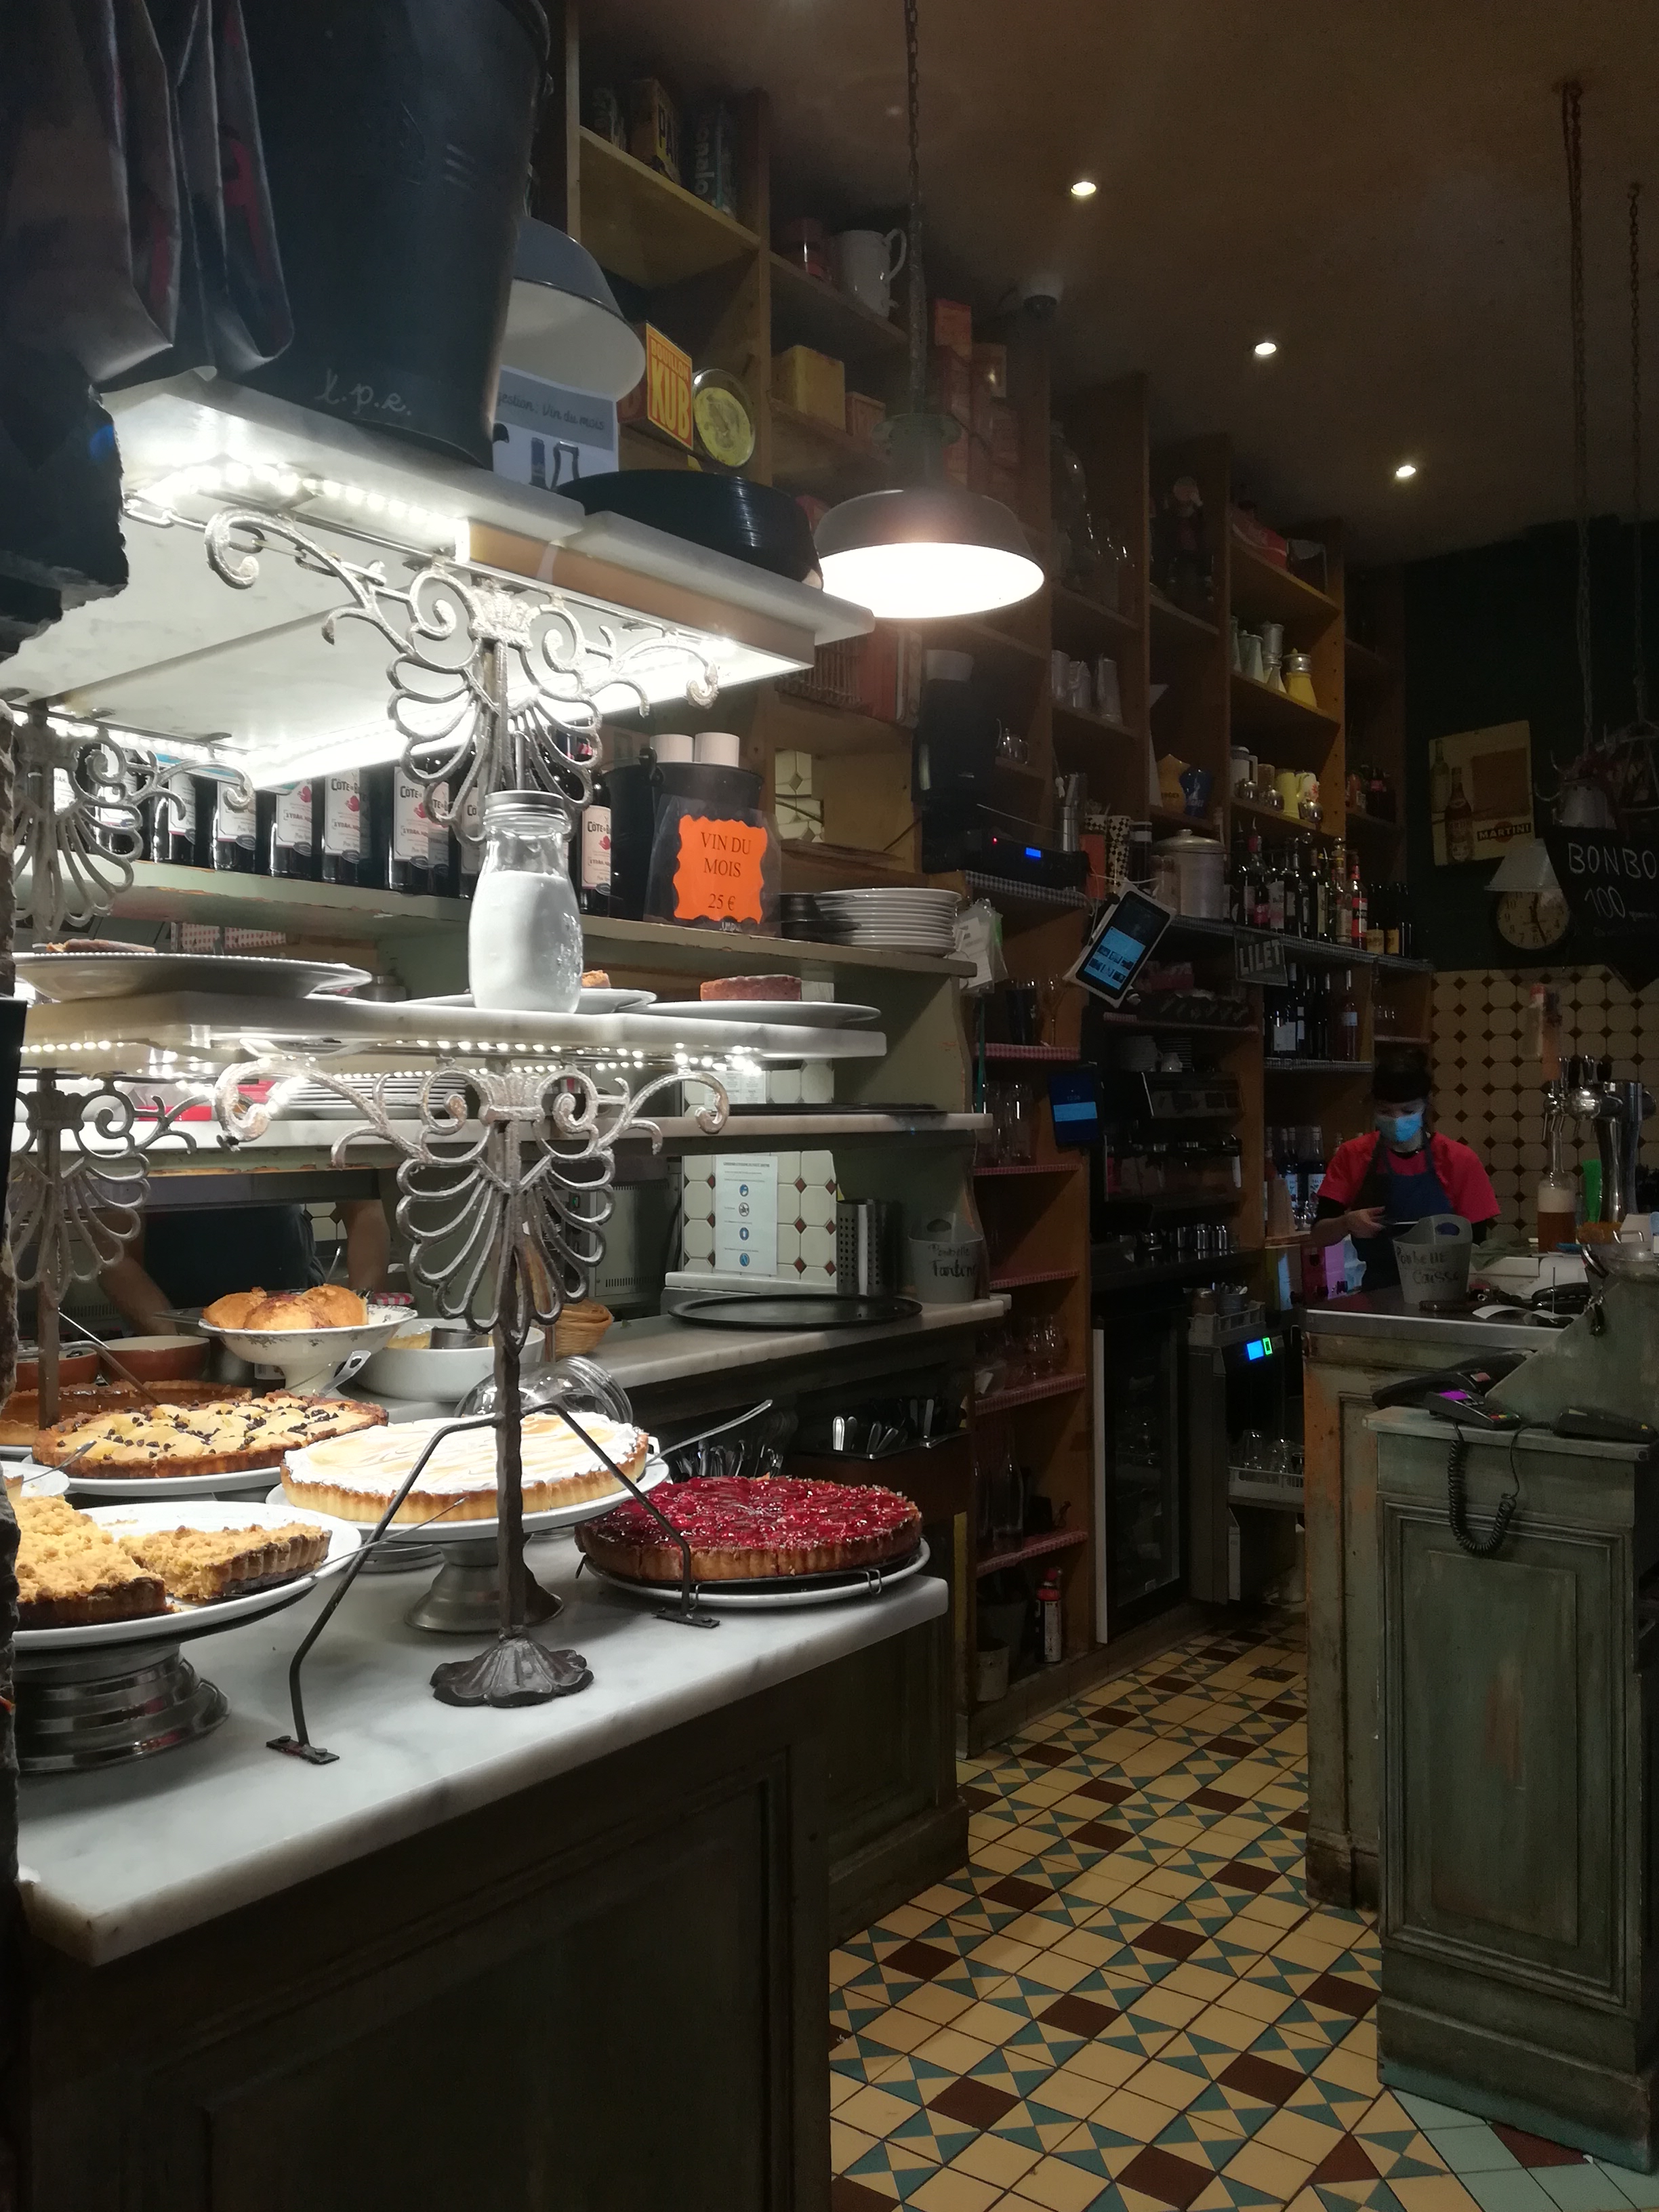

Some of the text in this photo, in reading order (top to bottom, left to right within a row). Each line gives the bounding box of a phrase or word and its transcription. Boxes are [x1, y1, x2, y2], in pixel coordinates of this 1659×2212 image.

[650, 338, 689, 380] BOUILLON
[651, 356, 690, 439] KUB
[542, 403, 562, 421] Vin
[564, 409, 578, 424] du
[579, 417, 606, 430] mois
[701, 832, 752, 855] VIN DU
[1479, 823, 1531, 840] MARTINI
[703, 857, 741, 878] MOIS
[708, 893, 736, 912] 25 €
[1584, 886, 1626, 919] 100
